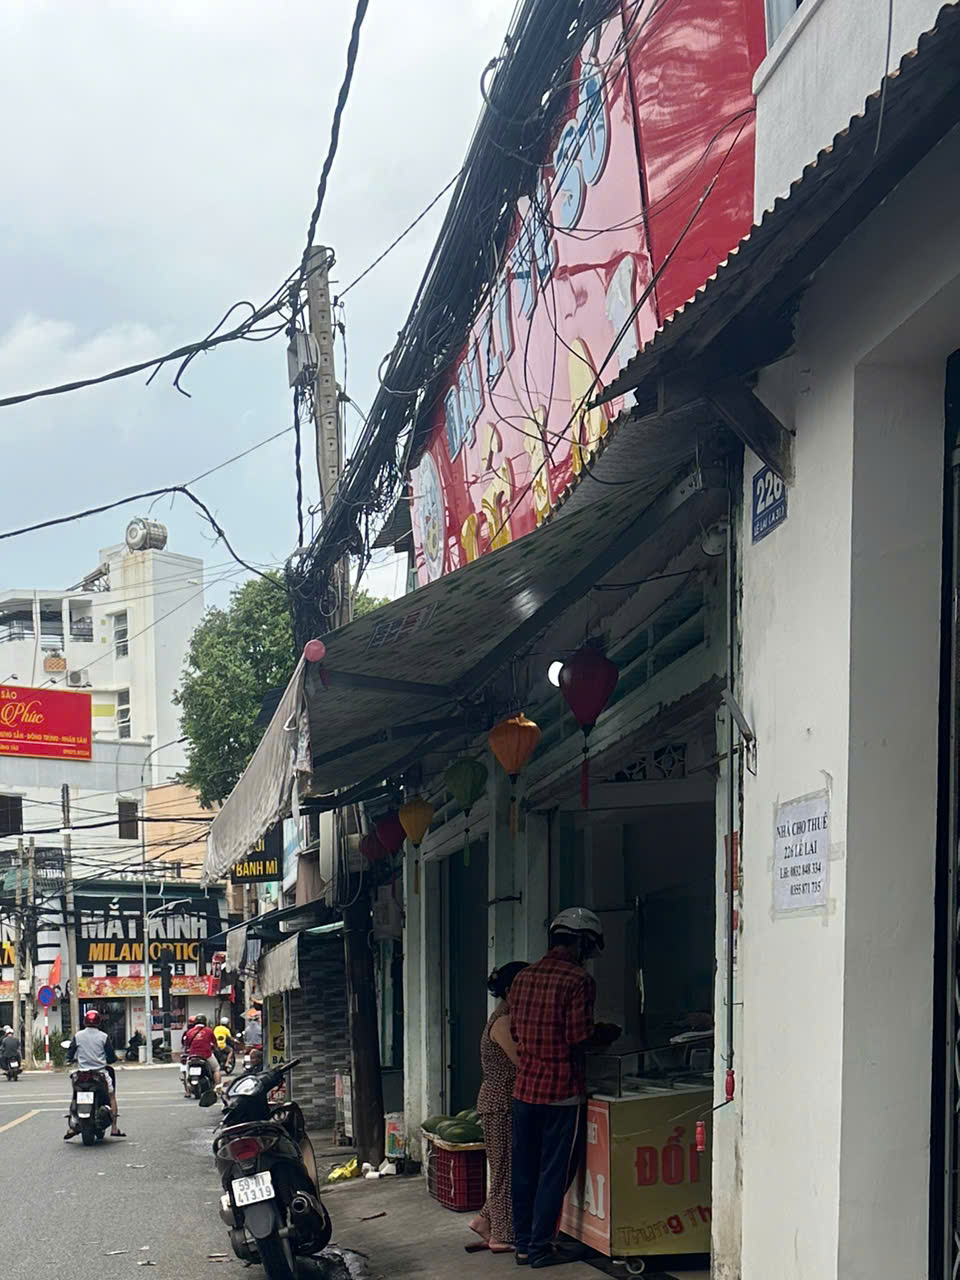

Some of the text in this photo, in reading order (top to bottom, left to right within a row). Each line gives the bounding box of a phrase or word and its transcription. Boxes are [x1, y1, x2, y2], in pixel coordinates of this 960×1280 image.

[1, 688, 18, 700] SÀO
[0, 700, 45, 728] Phúc
[776, 811, 828, 839] NHÀ CHO THUÊ
[804, 840, 818, 856] LAI
[80, 897, 208, 940] MẮT KÍNH
[88, 942, 145, 962] MILAN
[684, 1204, 713, 1228] Th
